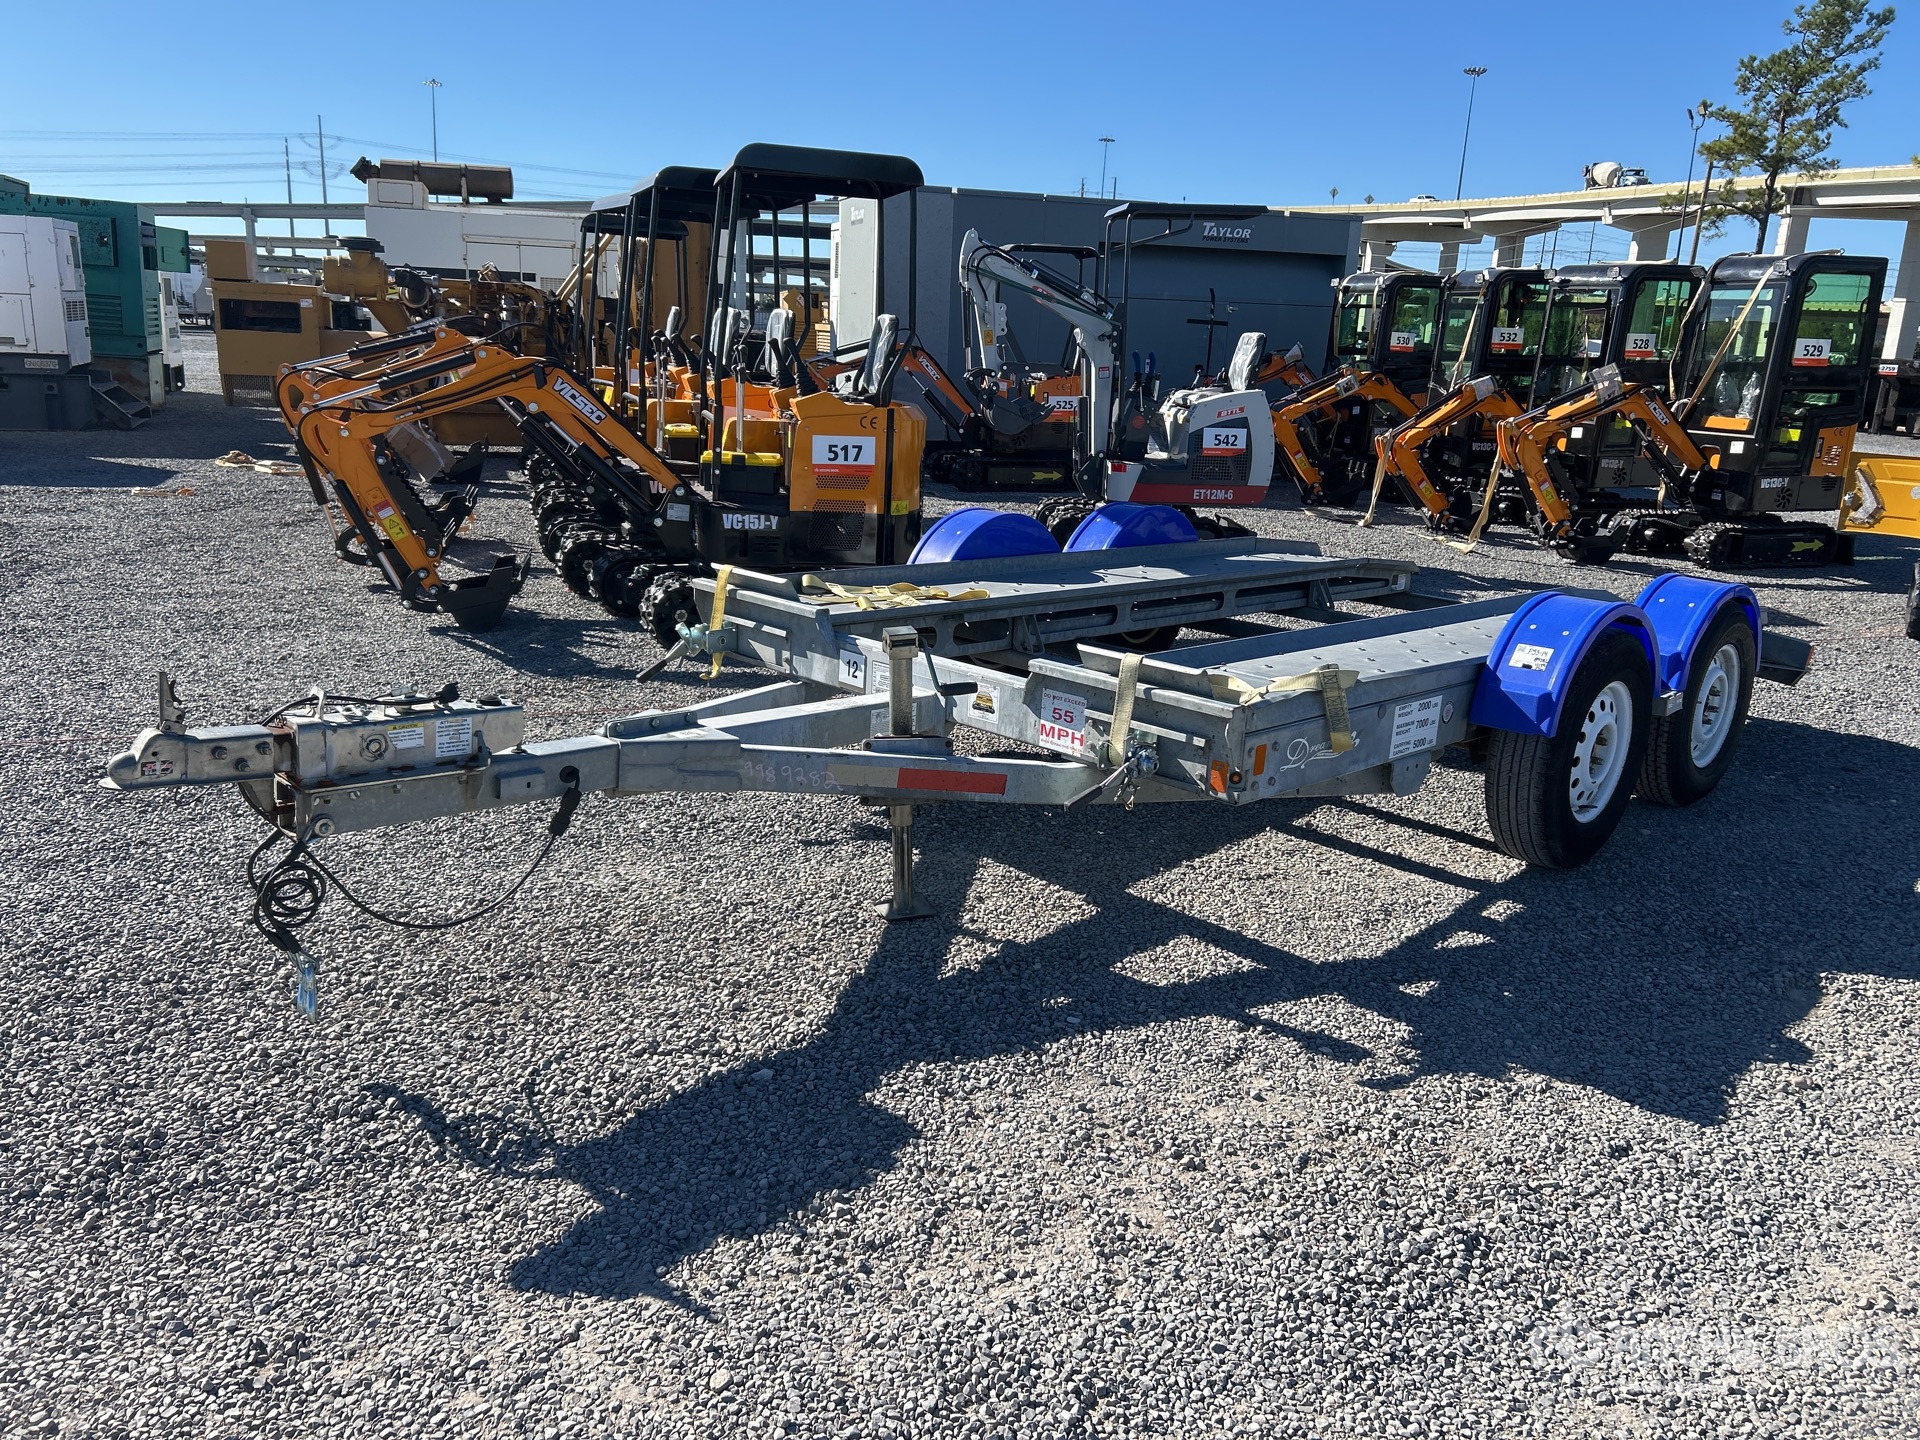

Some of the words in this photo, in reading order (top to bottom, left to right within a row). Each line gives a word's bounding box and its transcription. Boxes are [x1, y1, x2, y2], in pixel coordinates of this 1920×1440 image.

[1203, 222, 1251, 238] TAYLOR
[1396, 336, 1410, 345] 530
[1500, 332, 1518, 342] 532
[1632, 338, 1650, 349] 528
[1803, 344, 1823, 357] 529
[553, 376, 607, 425] VICSEC
[1056, 400, 1074, 410] 525
[1213, 434, 1238, 447] 542
[827, 444, 863, 462] 517
[1760, 478, 1789, 488] VC13C-Y
[1193, 489, 1233, 500] ET12M-6
[722, 513, 779, 530] VC15J-Y
[846, 659, 858, 679] 12
[1063, 697, 1086, 707] EXCEED
[1398, 703, 1412, 711] EMPTY
[1418, 700, 1432, 711] 2000
[1051, 707, 1075, 724] 55
[1398, 710, 1414, 718] WEIGHT
[1415, 718, 1429, 729] 7000
[1040, 723, 1084, 746] MPH
[1412, 737, 1427, 749] 5000
